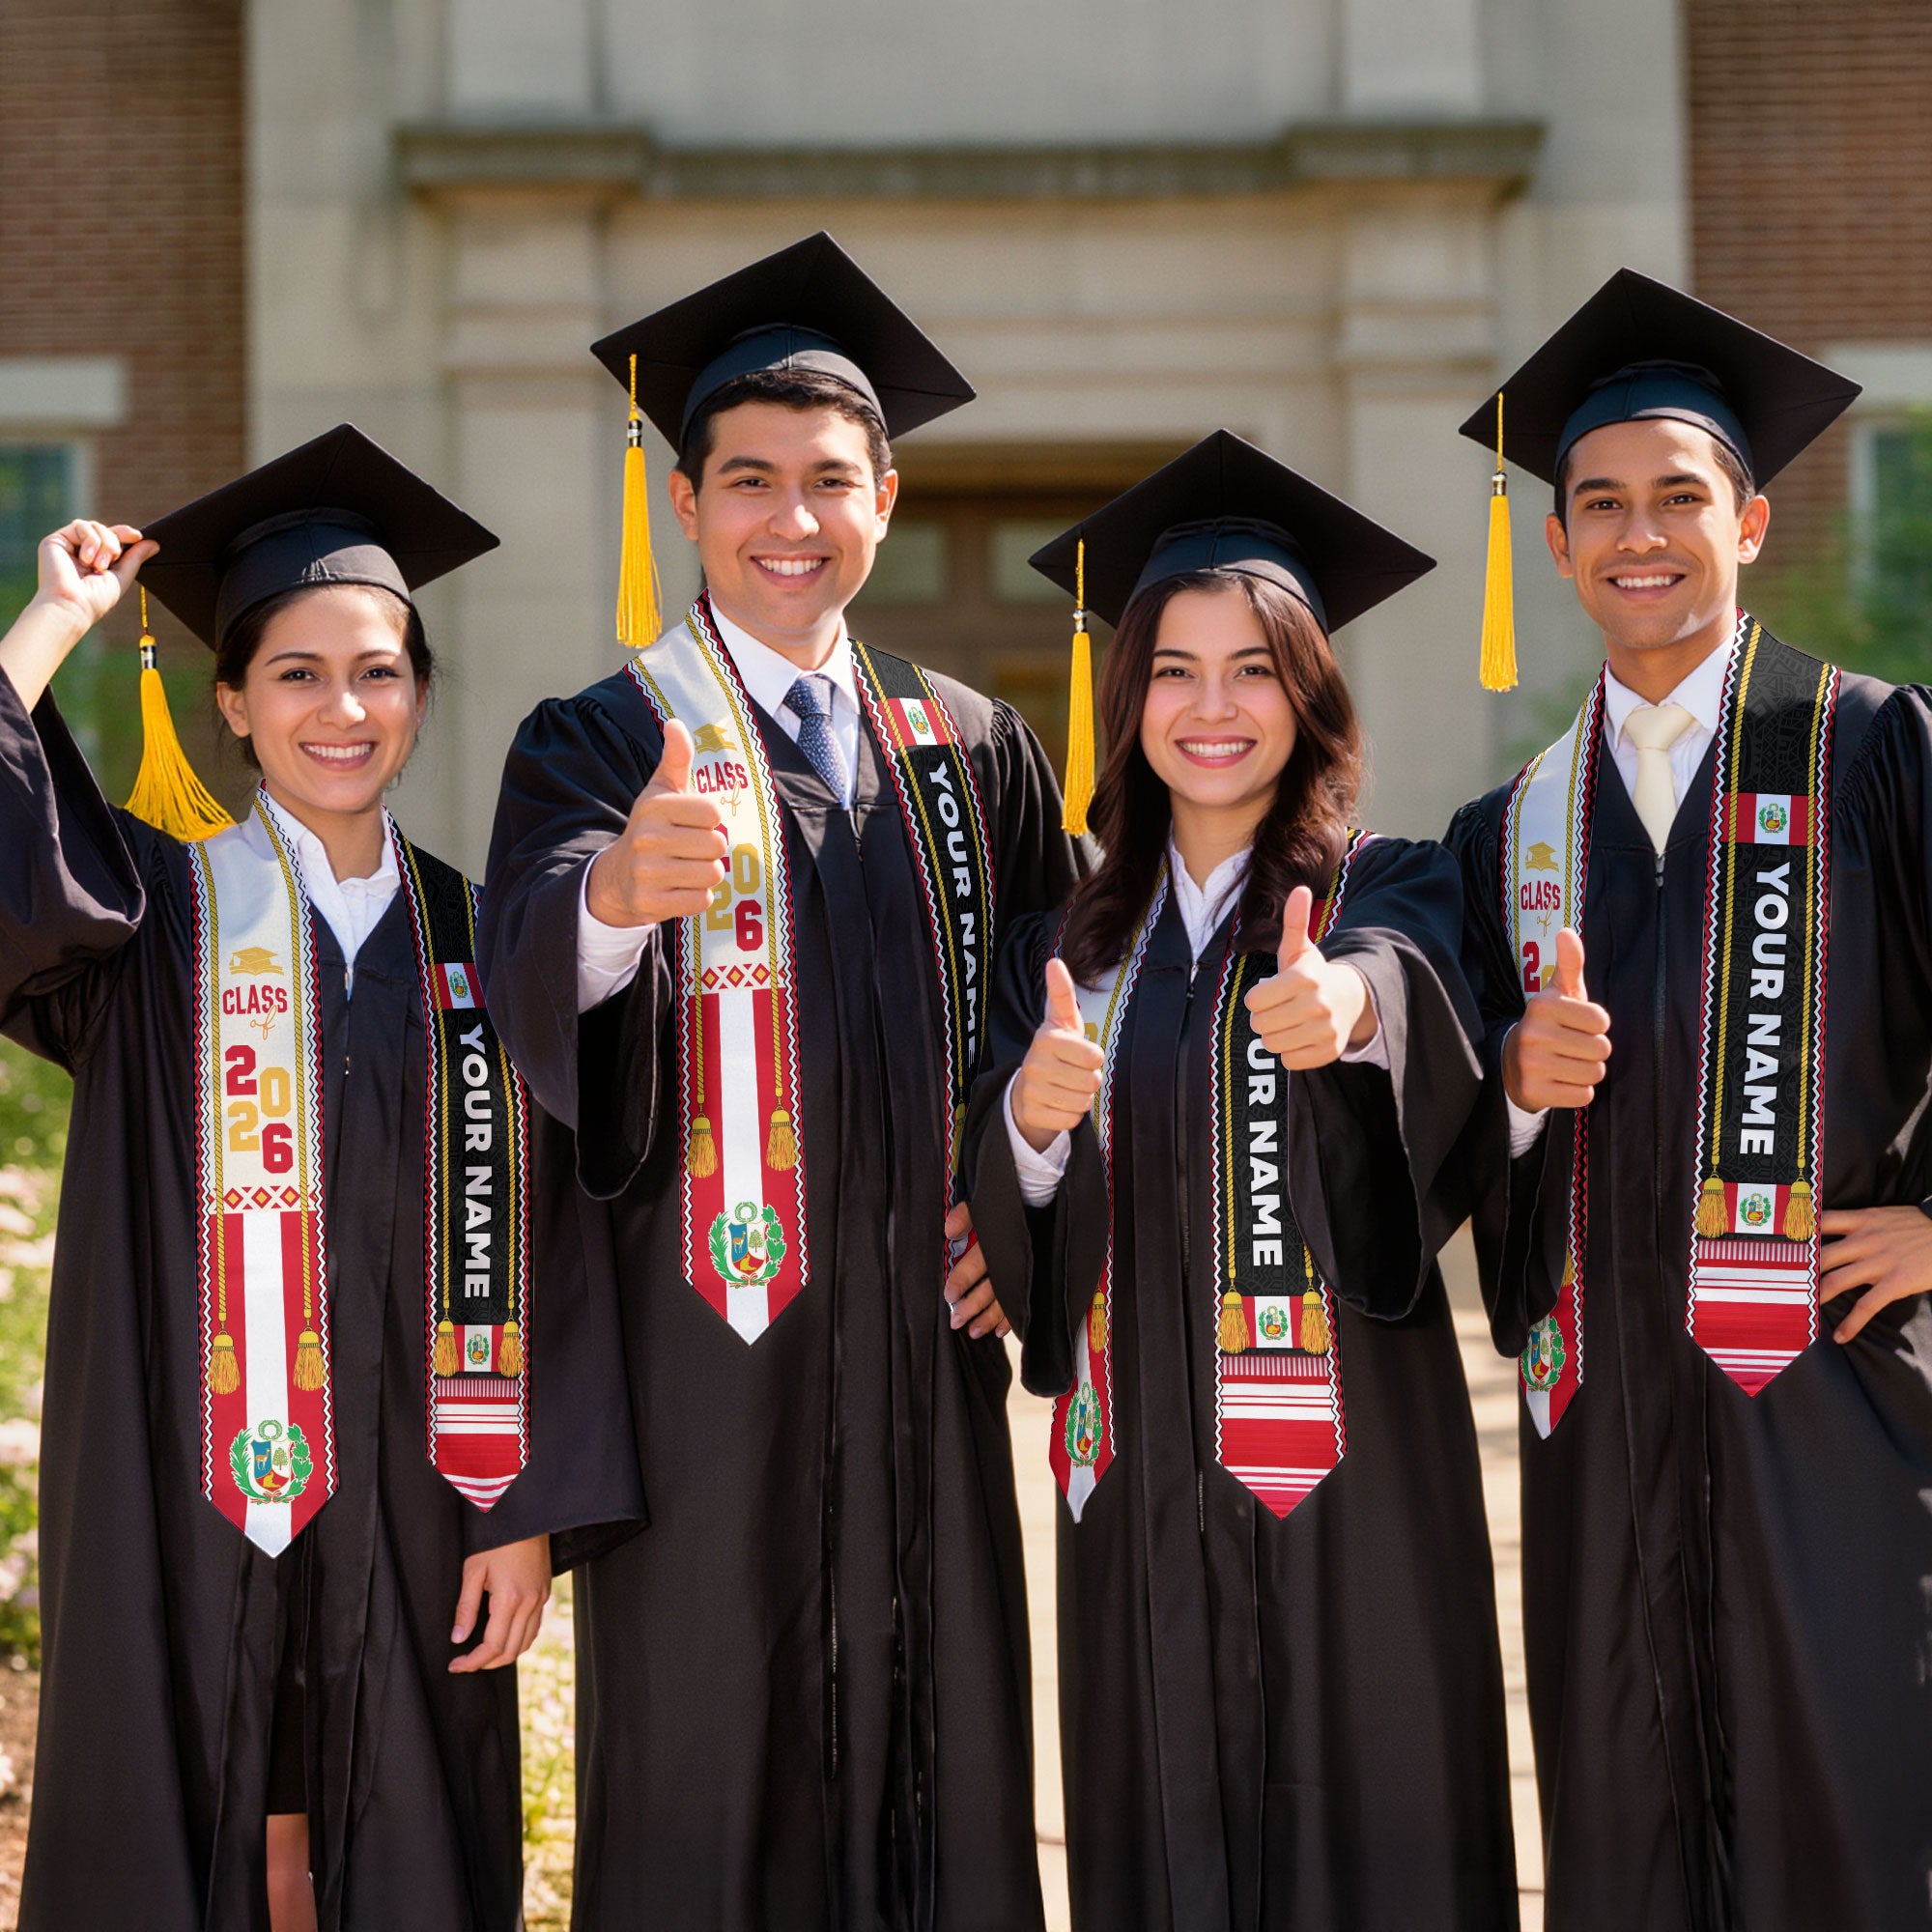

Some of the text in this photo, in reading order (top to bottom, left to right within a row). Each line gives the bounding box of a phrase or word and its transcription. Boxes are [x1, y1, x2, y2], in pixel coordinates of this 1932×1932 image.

[696, 761, 749, 794] CLASS
[720, 781, 741, 817] of
[928, 760, 975, 898] YOUR
[1520, 880, 1561, 911] CLASS
[706, 879, 763, 952] 26
[1537, 902, 1553, 937] of
[222, 984, 288, 1015] CLASS
[1740, 863, 1790, 1155] YOUR NAME
[249, 1005, 278, 1040] of
[459, 1023, 493, 1298] YOUR NAME
[1248, 1121, 1283, 1266] NAME
